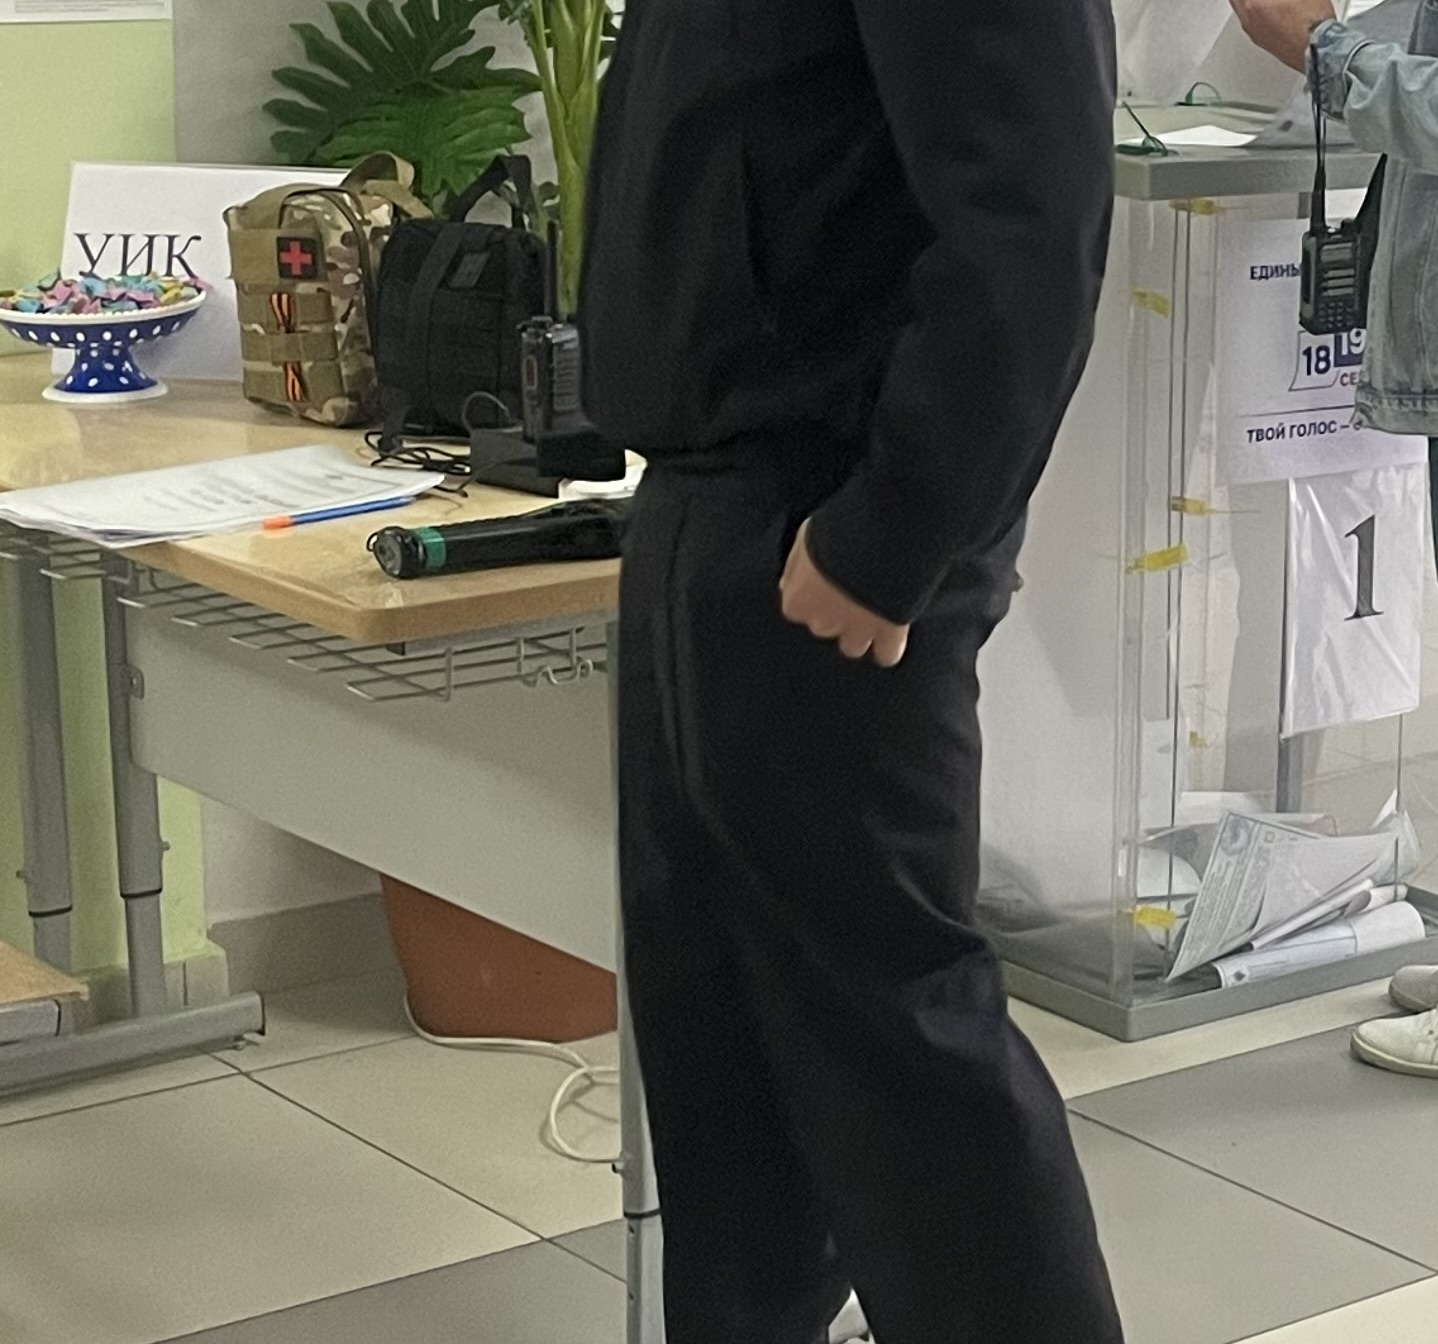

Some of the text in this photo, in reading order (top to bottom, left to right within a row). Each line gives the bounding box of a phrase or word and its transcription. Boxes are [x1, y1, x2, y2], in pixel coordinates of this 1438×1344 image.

[73, 232, 202, 280] УИК
[1250, 263, 1300, 280] ЕДИНЫ
[1302, 328, 1366, 376] 18 19
[1247, 422, 1286, 443] ТВОЙ
[1289, 420, 1337, 439] ГОЛОС
[1344, 515, 1384, 621] 1
